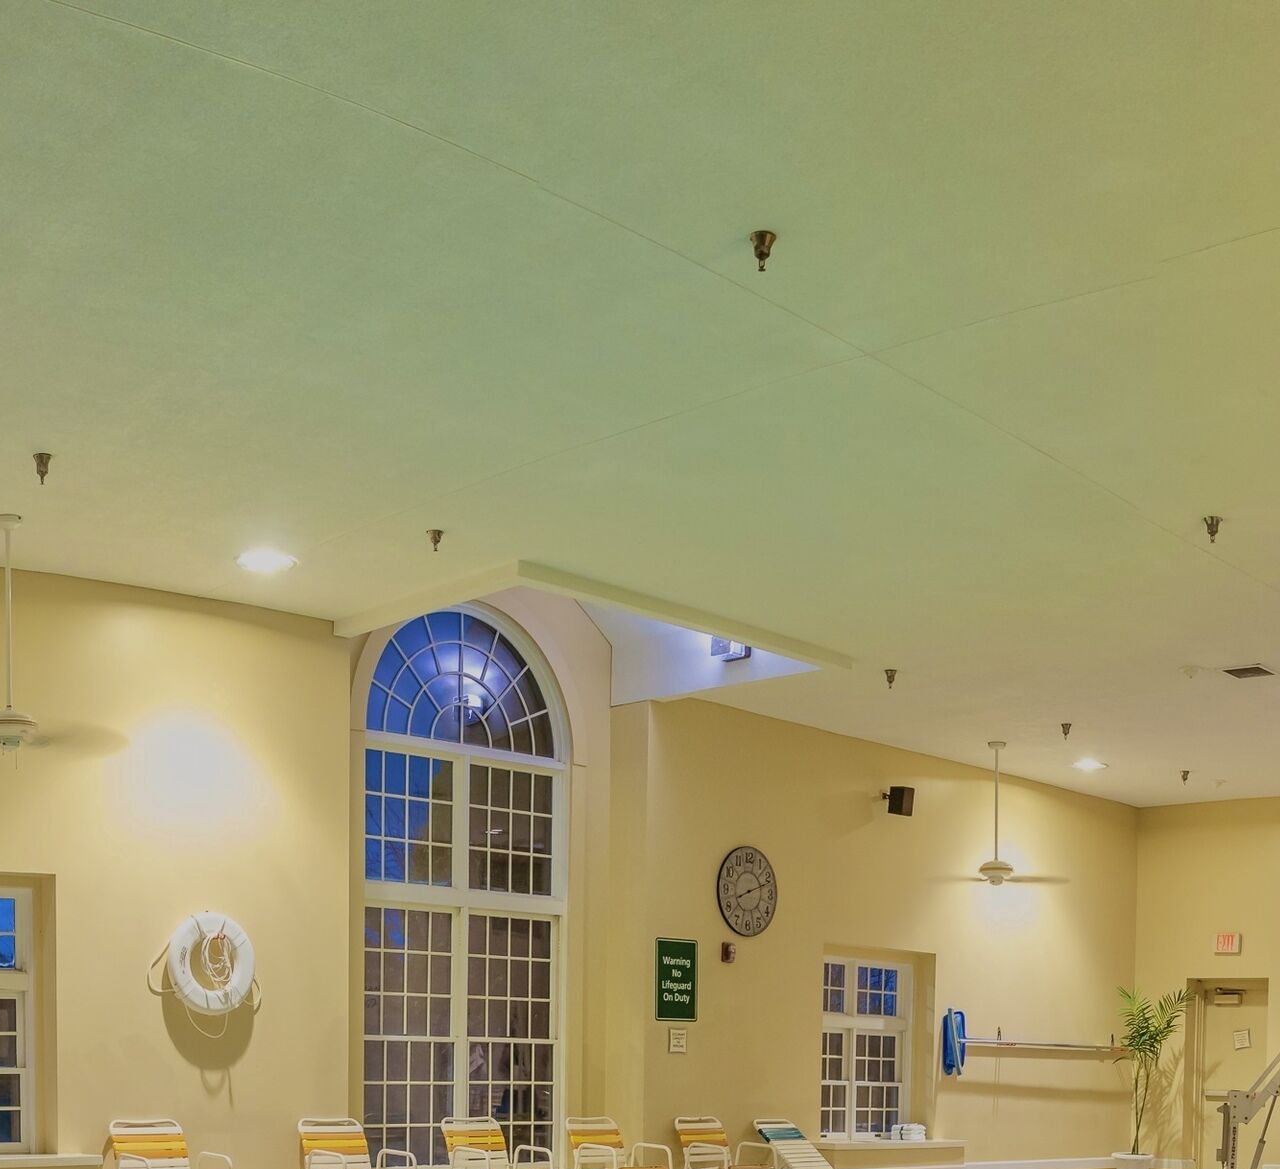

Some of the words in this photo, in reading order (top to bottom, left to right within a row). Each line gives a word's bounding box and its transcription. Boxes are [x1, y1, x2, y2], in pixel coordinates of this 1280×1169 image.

[735, 855, 742, 867] 11
[745, 852, 754, 864] 12
[726, 866, 734, 878] 10
[765, 871, 771, 884] 2
[723, 883, 729, 895] 9
[767, 889, 773, 901] 3
[725, 901, 732, 913] 8
[764, 906, 770, 918] 4
[734, 914, 740, 926] 7
[745, 920, 751, 931] 6
[755, 917, 762, 929] 5
[1216, 934, 1234, 951] EXIT
[662, 956, 691, 968] Warning
[672, 969, 682, 978] No
[661, 980, 692, 992] Lifeguard
[663, 992, 673, 1002] On
[674, 993, 690, 1005] Duty
